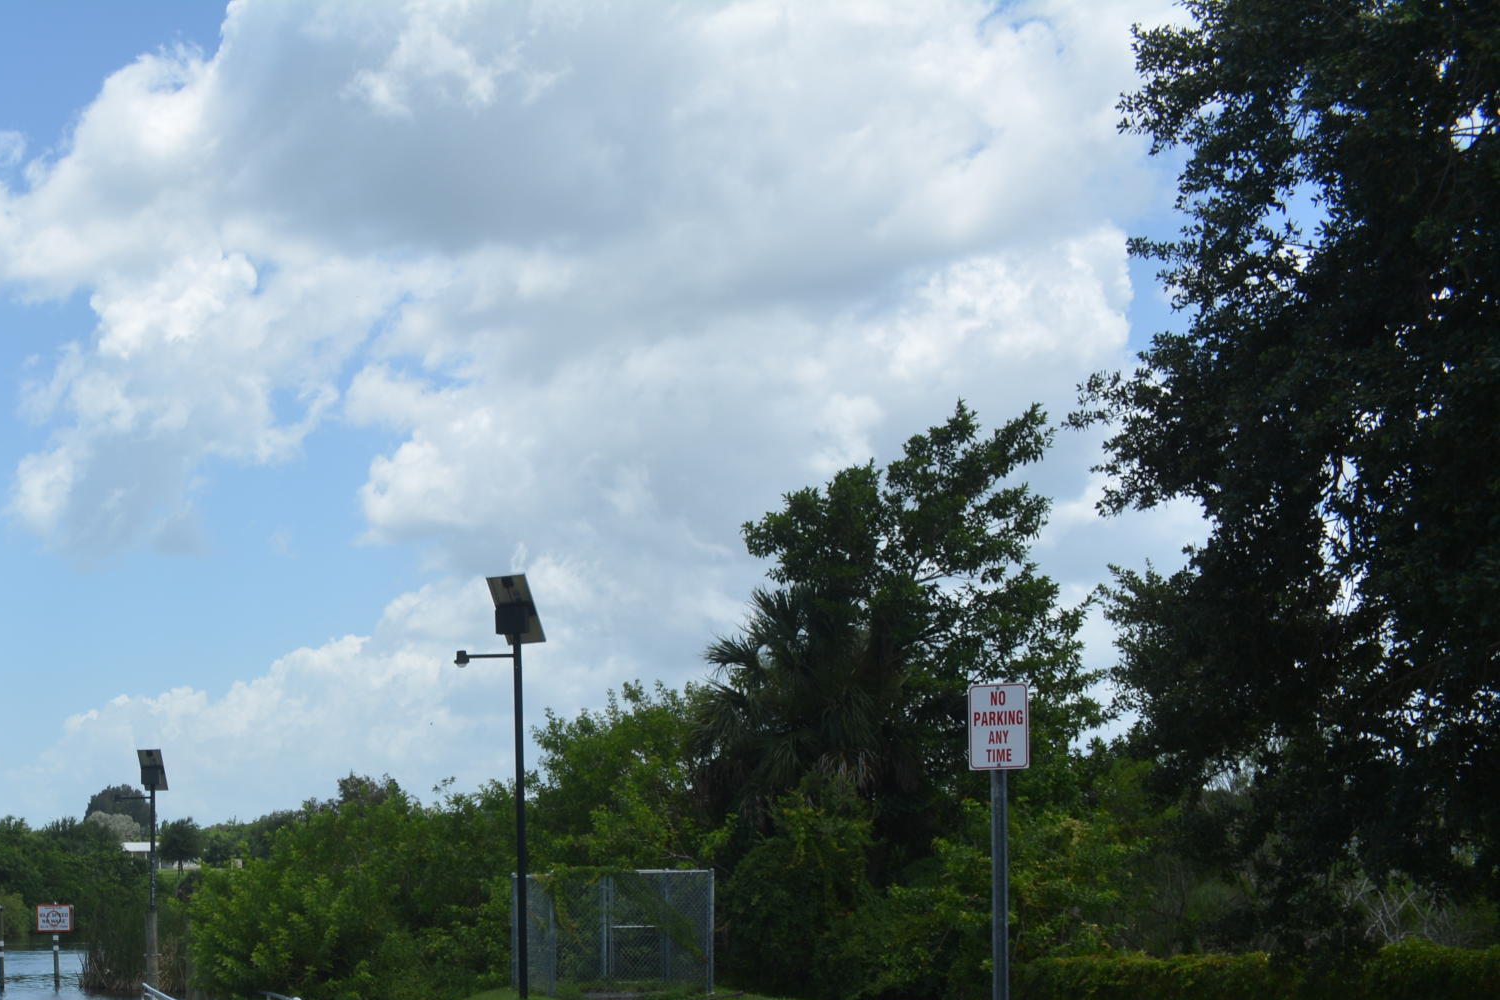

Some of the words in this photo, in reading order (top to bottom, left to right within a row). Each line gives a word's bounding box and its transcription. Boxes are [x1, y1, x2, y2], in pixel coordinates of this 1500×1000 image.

[990, 690, 1006, 706] NO
[973, 710, 1024, 727] PARKING
[988, 730, 1009, 745] ANY
[986, 748, 1012, 763] TIME
